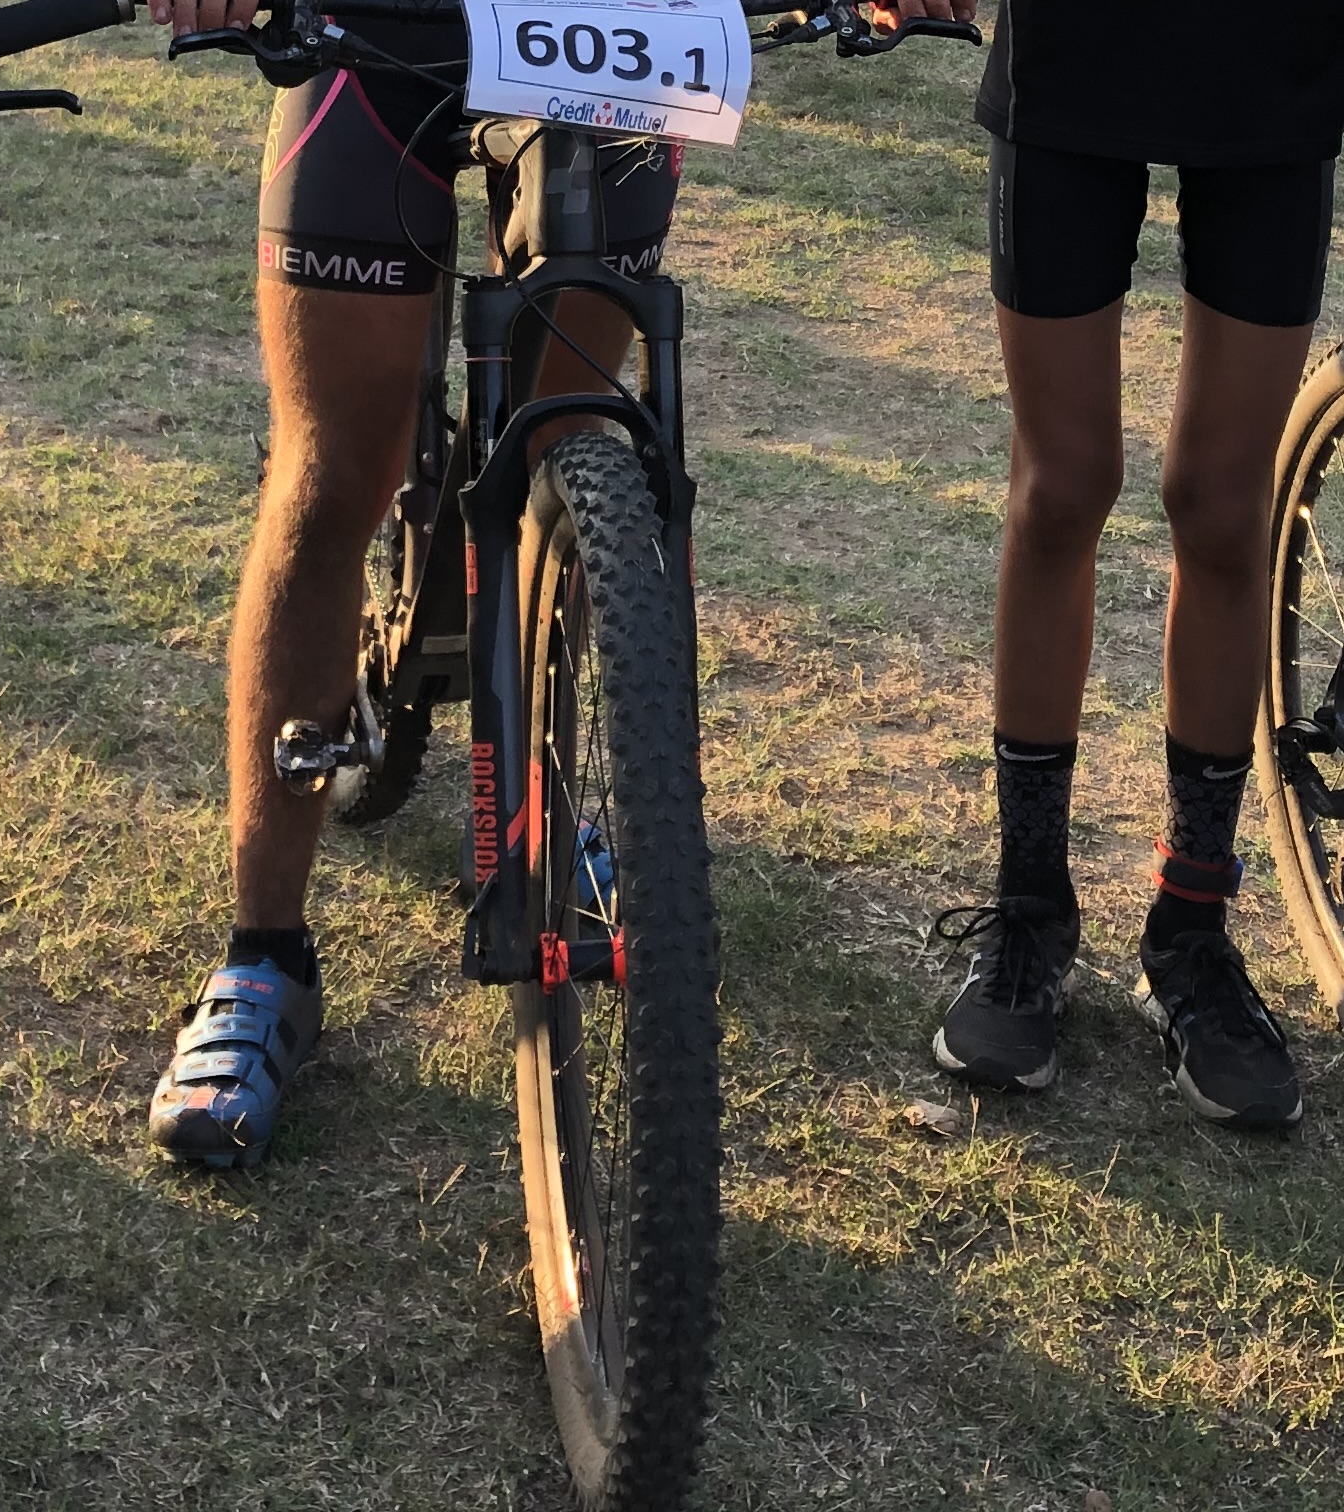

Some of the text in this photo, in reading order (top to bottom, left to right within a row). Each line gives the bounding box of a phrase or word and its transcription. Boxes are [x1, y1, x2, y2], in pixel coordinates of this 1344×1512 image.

[516, 20, 711, 93] 603.1
[546, 96, 669, 134] Crédit Mutuel
[259, 240, 406, 286] BIEMME
[472, 743, 499, 884] ROCKSHOX
